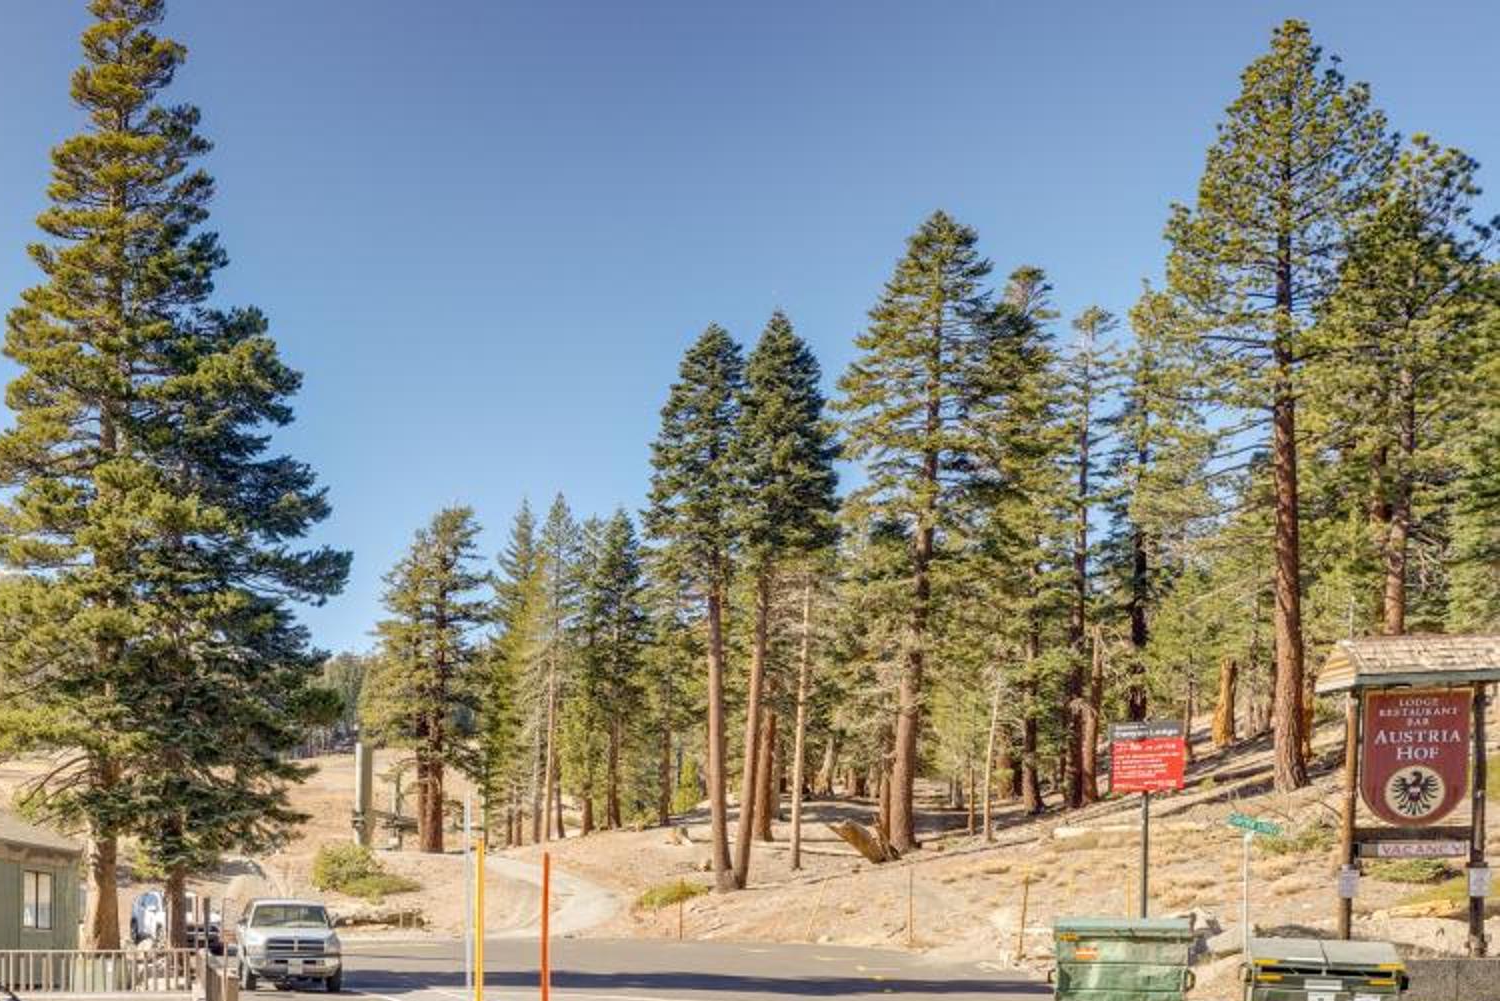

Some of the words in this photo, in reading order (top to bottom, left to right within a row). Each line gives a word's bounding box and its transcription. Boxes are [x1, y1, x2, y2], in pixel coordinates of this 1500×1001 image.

[1399, 698, 1439, 708] LODGE
[1379, 706, 1458, 717] RESTAURANT
[1407, 717, 1430, 727] BAR
[1374, 729, 1461, 745] AUSTRIA
[1395, 746, 1440, 761] HOF
